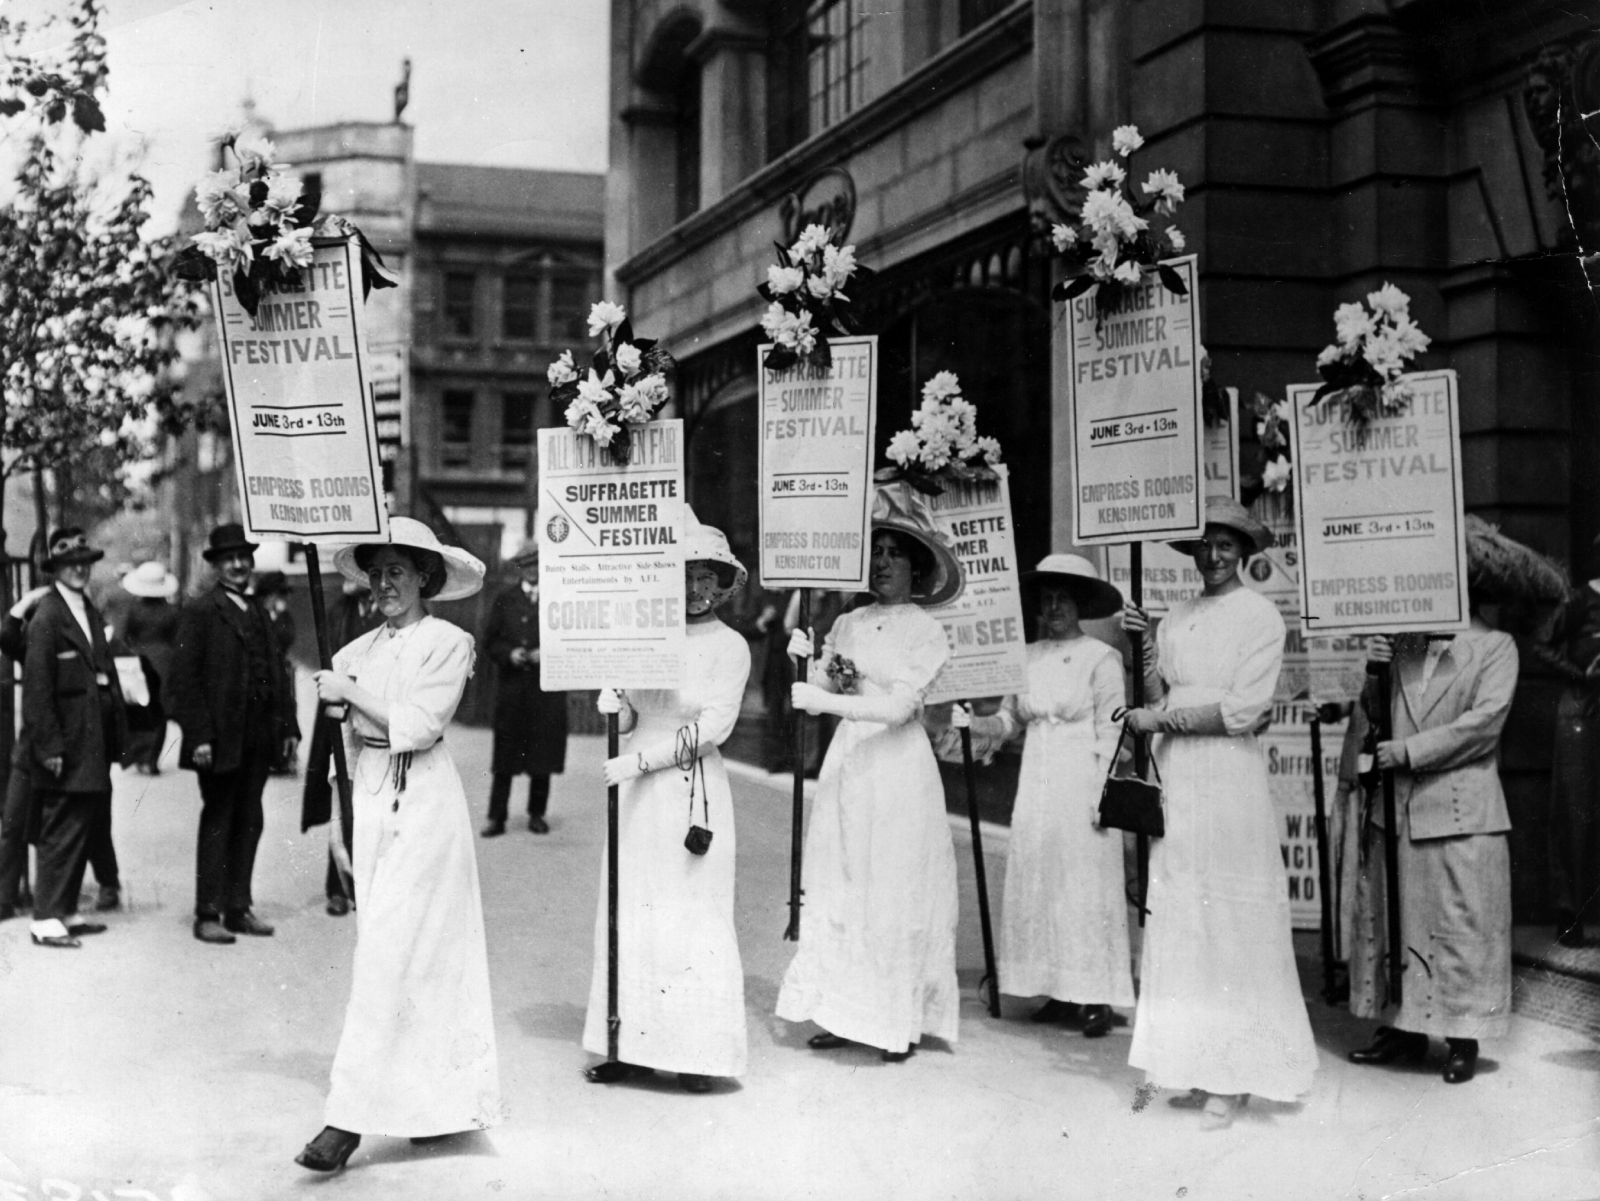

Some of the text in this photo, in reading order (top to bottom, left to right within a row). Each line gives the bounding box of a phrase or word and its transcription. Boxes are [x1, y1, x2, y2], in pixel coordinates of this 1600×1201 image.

[250, 300, 322, 332] SUMMER
[1096, 315, 1167, 352] SUMMER
[231, 335, 353, 364] FESTIVAL
[1078, 346, 1190, 384] FESTIVAL
[781, 386, 844, 413] SUMMER
[252, 413, 281, 428] JUNE
[766, 416, 864, 440] FESTIVAL
[1090, 424, 1121, 440] JUNE
[1329, 424, 1419, 454] SUMMER
[547, 435, 569, 470] ALL
[650, 427, 677, 465] FAIR
[1305, 453, 1448, 484] FESTIVAL
[249, 476, 370, 499] EMPRESS ROOMS
[566, 480, 677, 502] SUFFRAGETTE
[772, 480, 796, 492] JUNE
[1082, 474, 1194, 503] EMPRESS ROOMS
[270, 503, 353, 524] KENSINGTON
[586, 504, 658, 524] SUMMER
[1098, 502, 1175, 524] KENSINGTON
[600, 526, 677, 547] FESTIVAL
[765, 532, 860, 549] EMPRESS ROOMS
[1322, 522, 1363, 537] JUNE
[545, 565, 566, 573] Dainty
[598, 562, 632, 571] Attractive
[775, 555, 841, 570] KENSINGTON
[562, 575, 618, 585] Entertainments
[624, 575, 633, 584] by
[1113, 567, 1177, 583] EMRESS
[1311, 572, 1455, 597] EMPRESS ROOMS
[547, 597, 679, 630] COME AND SEE
[1334, 598, 1433, 616] KENSINGTON
[975, 617, 1019, 646] SEE
